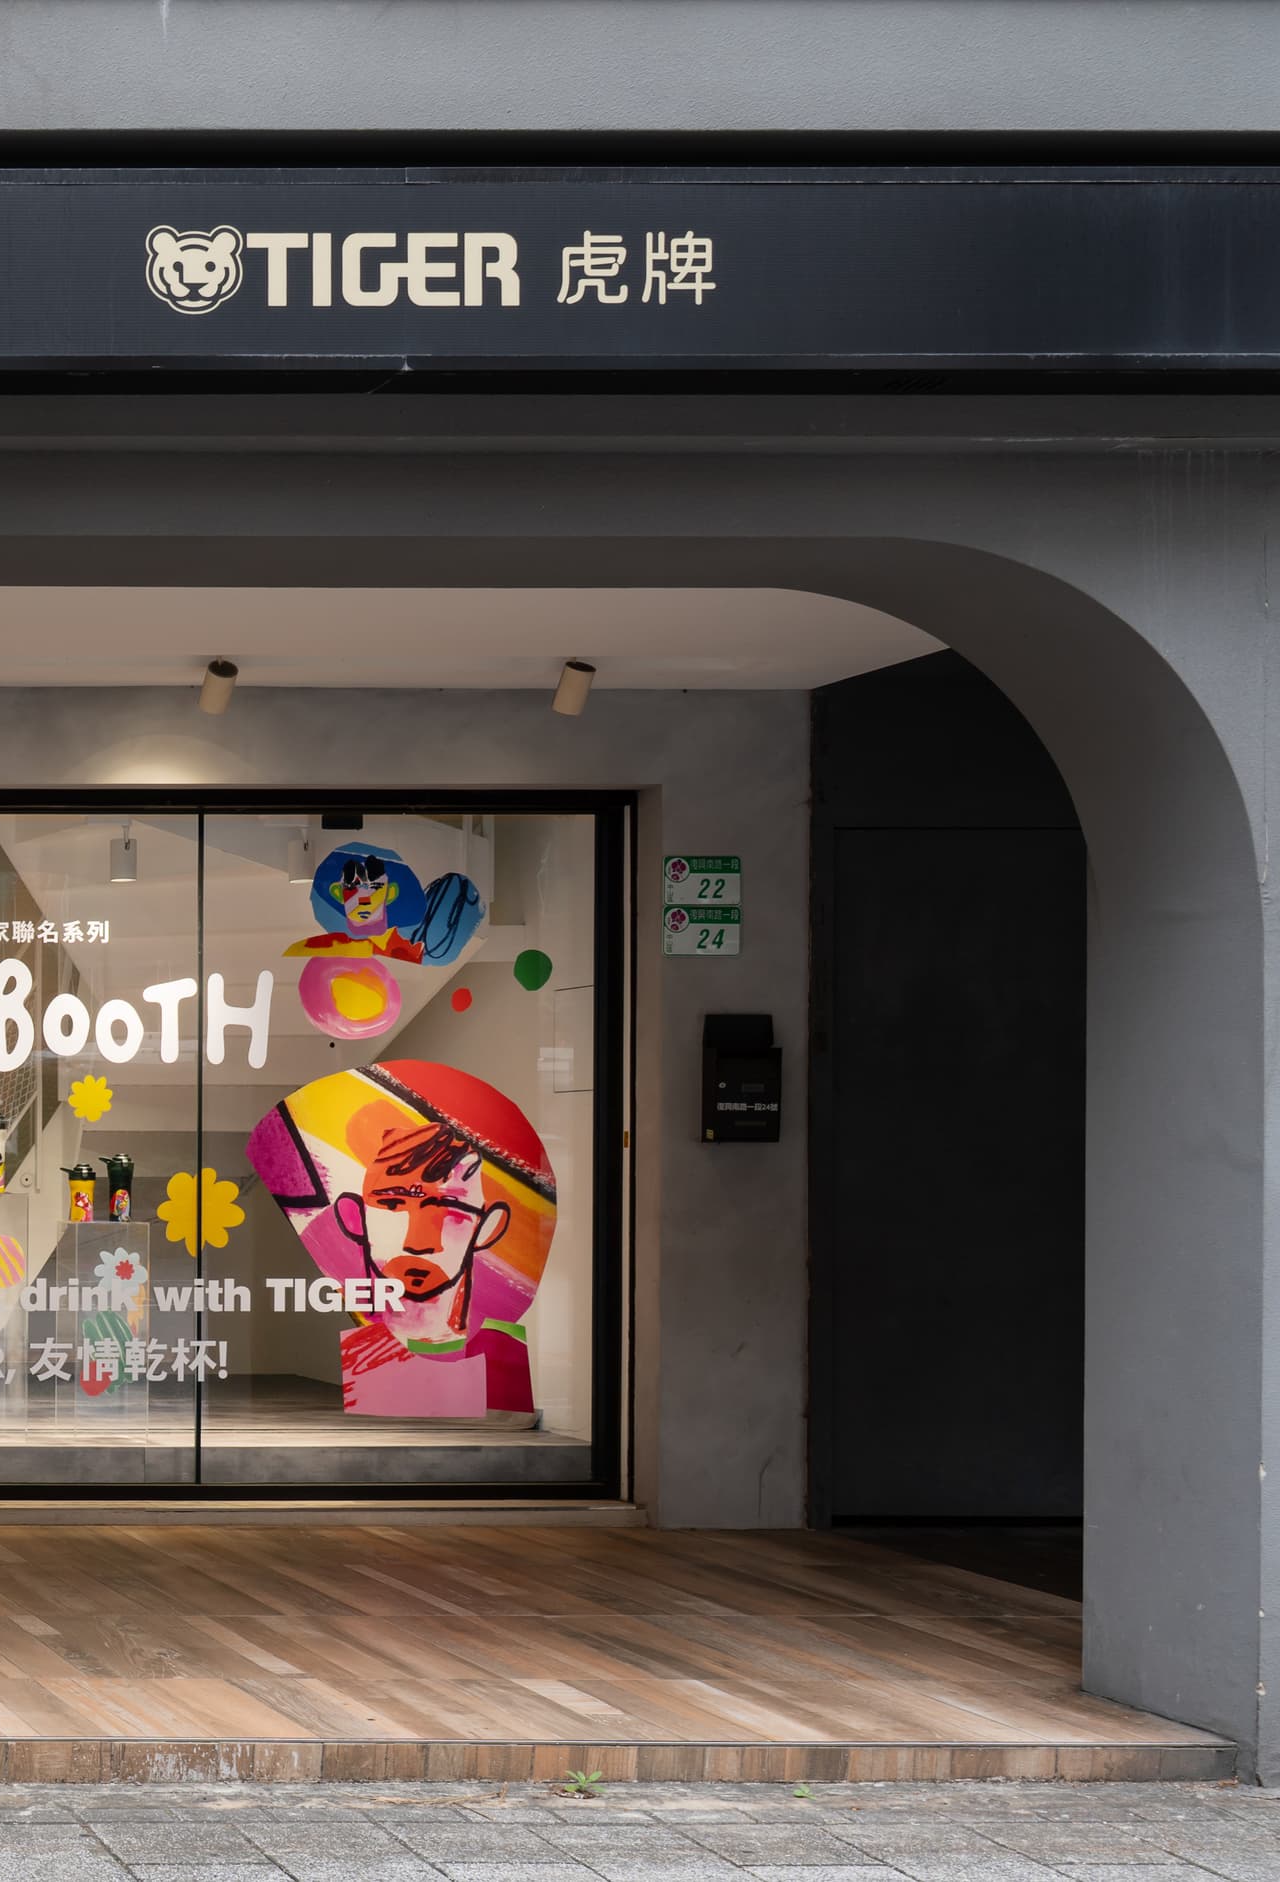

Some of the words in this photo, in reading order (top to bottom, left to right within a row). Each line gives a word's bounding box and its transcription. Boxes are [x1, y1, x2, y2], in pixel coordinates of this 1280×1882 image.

[246, 232, 521, 307] TIGER
[557, 230, 717, 305] 虎牌
[697, 878, 726, 899] 22
[696, 928, 725, 949] 24
[20, 1276, 135, 1313] drink
[153, 1276, 252, 1313] with
[266, 1276, 406, 1313] TIGER
[29, 1336, 229, 1383] 友情乾杯!
